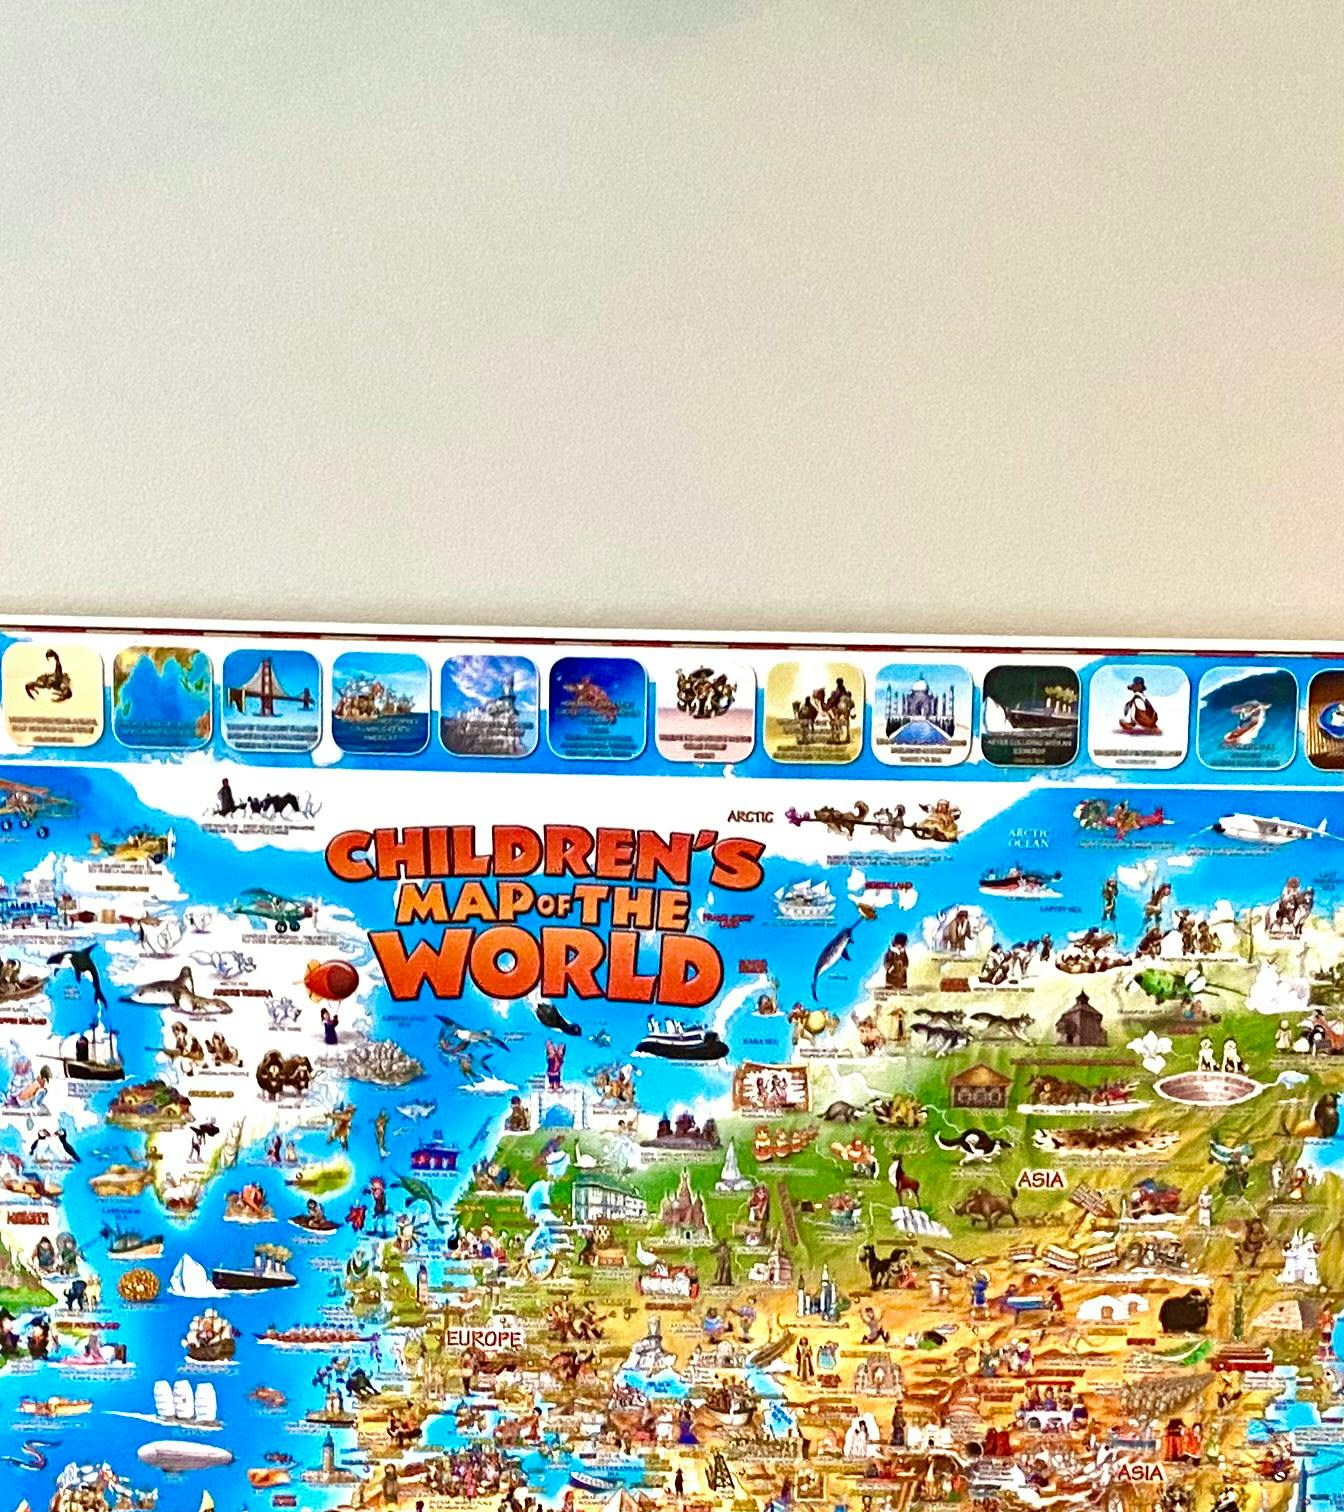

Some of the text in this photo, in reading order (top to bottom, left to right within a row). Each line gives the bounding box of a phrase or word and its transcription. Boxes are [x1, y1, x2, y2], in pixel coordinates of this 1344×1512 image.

[727, 809, 774, 823] ARCTIC
[325, 824, 766, 891] CHILDREN'S
[395, 880, 690, 931] MAP OF THE
[368, 925, 725, 1008] WORLD
[1019, 1170, 1065, 1189] ASIA
[447, 1330, 522, 1348] EUROPE
[1118, 1464, 1164, 1483] ASIA
